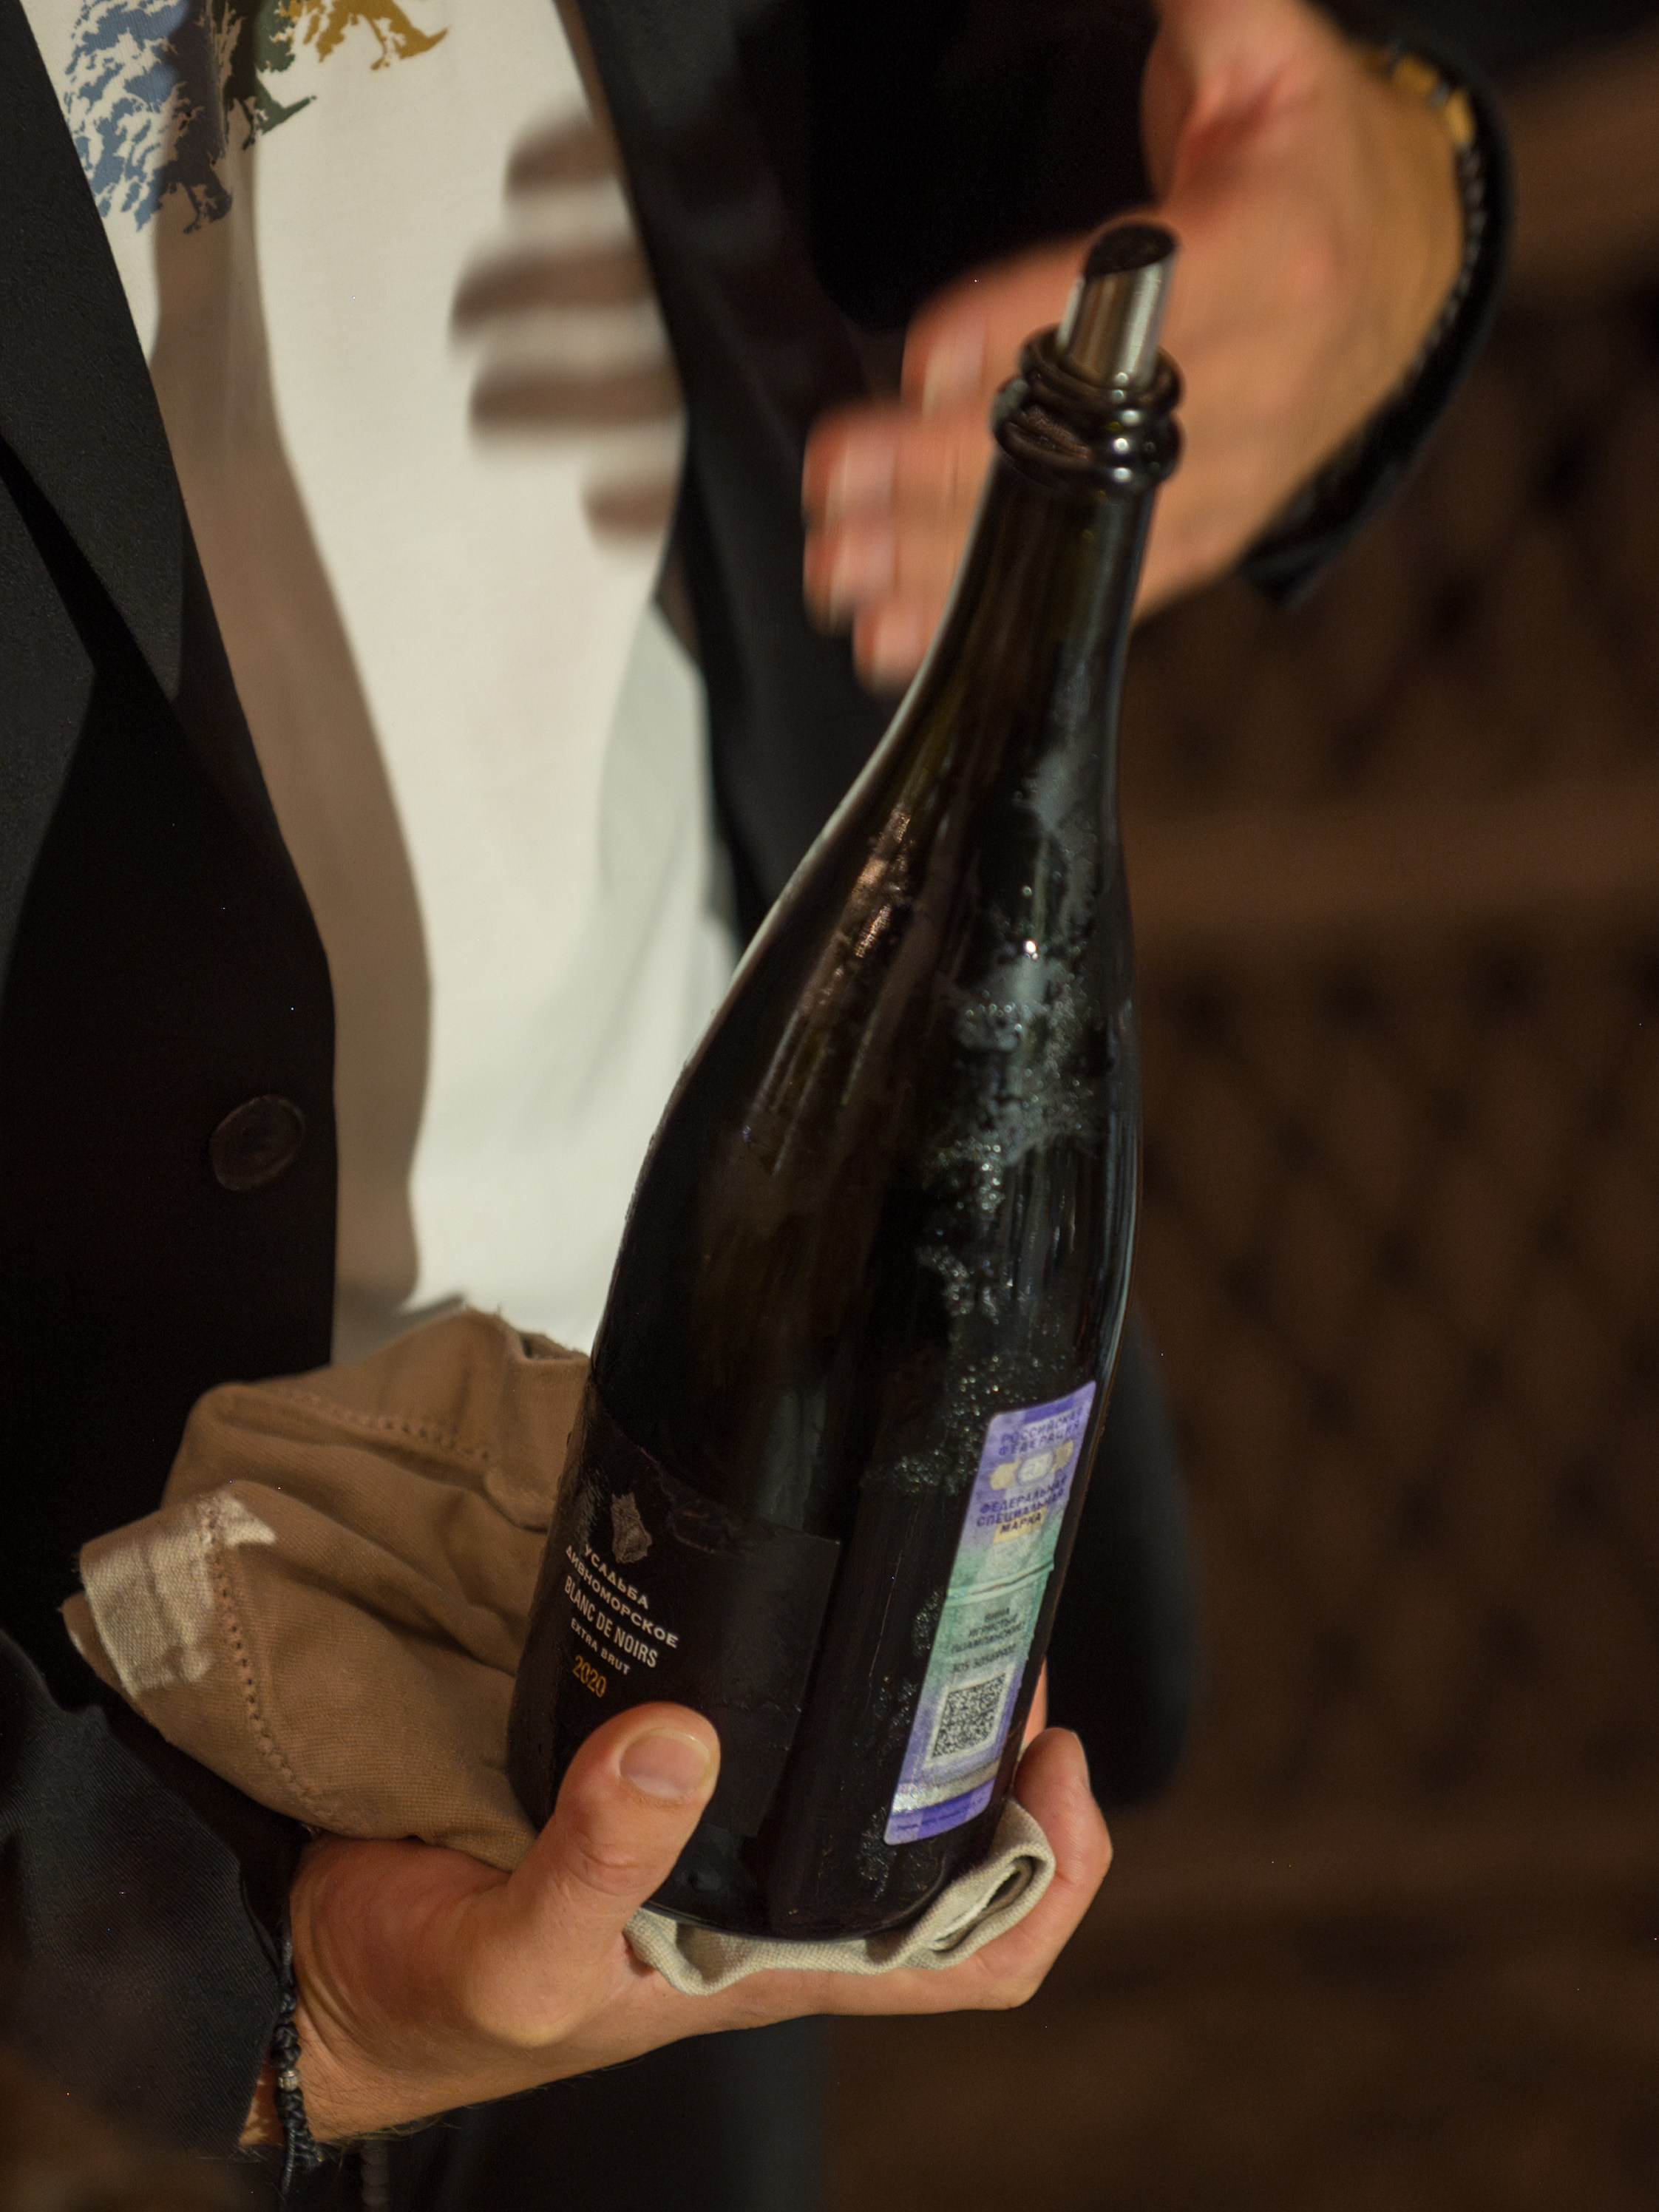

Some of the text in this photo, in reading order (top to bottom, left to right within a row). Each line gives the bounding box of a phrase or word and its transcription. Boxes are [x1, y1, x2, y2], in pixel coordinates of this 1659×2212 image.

[1000, 1513, 1042, 1533] МАРКА
[566, 1545, 679, 1649] ДИВНОМОРСКОЕ
[585, 1544, 649, 1610] УСАДЬБА
[564, 1575, 658, 1668] BLANC DE NOIRS
[571, 1618, 631, 1675] EXTRA BRUT
[572, 1655, 607, 1697] 2020
